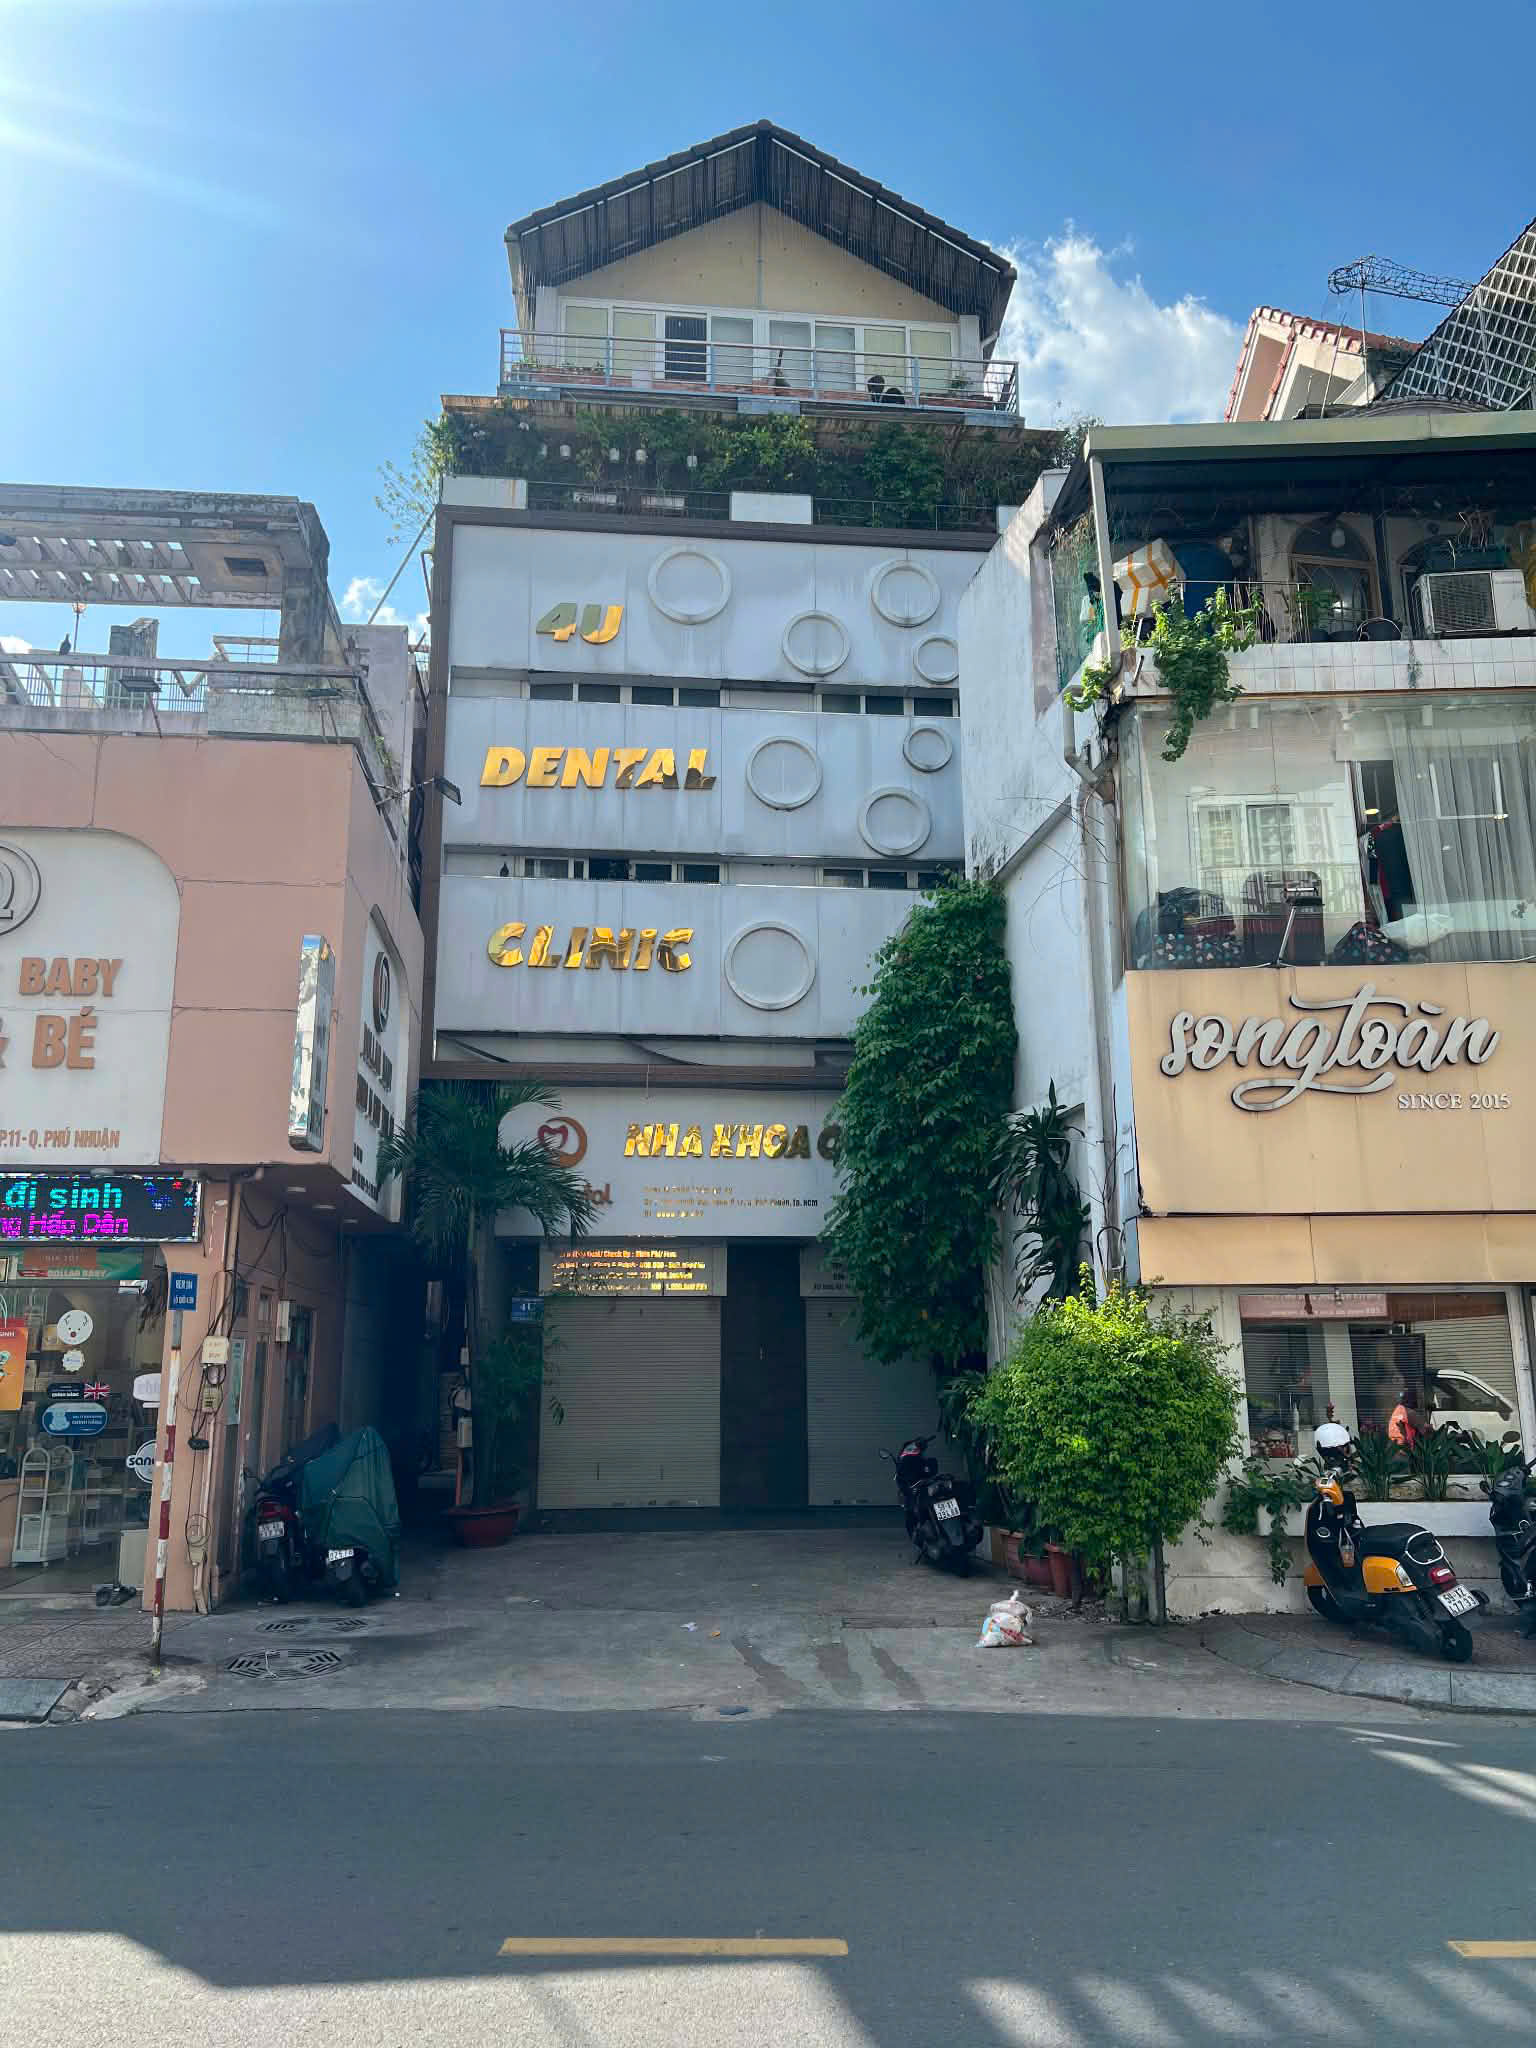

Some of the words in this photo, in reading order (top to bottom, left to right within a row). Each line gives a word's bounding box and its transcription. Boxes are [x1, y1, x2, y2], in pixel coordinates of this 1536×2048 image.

[535, 602, 624, 645] 4U
[479, 745, 717, 790] DENTAL
[486, 921, 695, 973] CLINIC
[18, 956, 124, 998] BABY
[31, 1005, 98, 1071] BÉ
[1398, 1093, 1462, 1110] SINCE
[1470, 1093, 1511, 1110] 2015
[623, 1123, 704, 1158] NHA
[708, 1123, 812, 1160] KHOA
